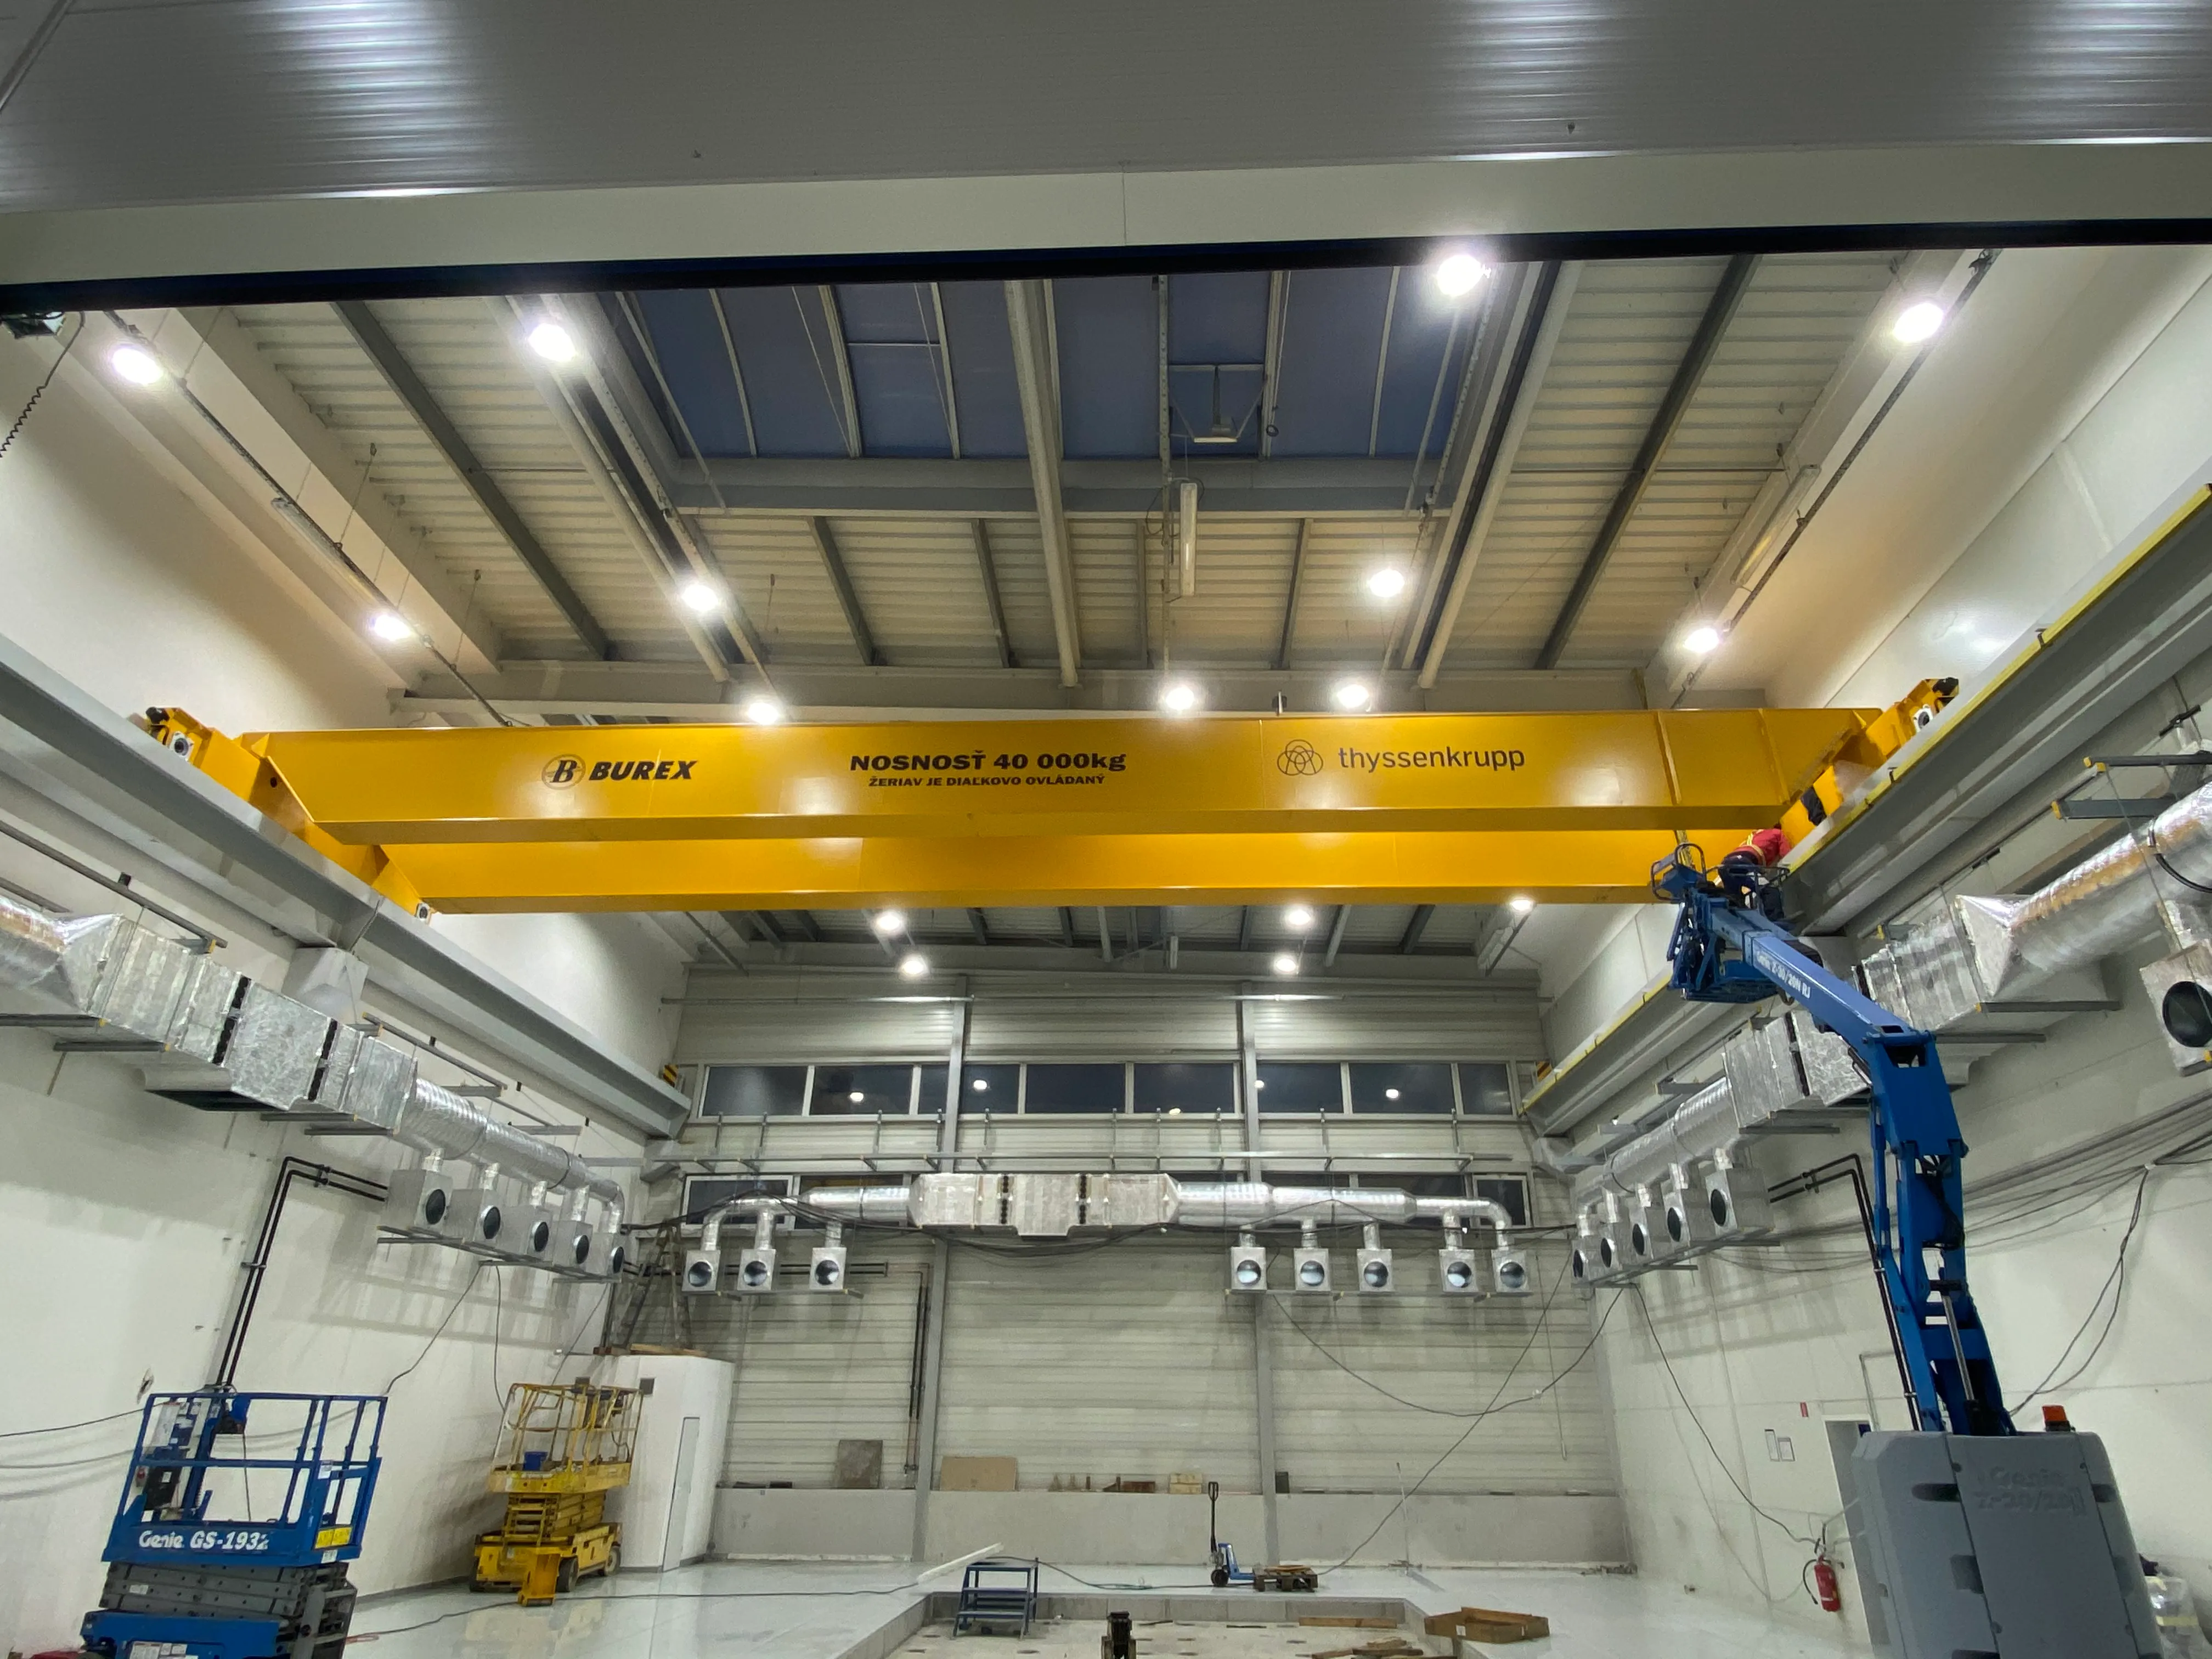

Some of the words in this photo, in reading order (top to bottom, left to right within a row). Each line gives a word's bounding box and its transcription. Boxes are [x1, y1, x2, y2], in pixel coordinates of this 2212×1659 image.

[588, 759, 699, 781] BUREX
[850, 749, 986, 771] NOSNOSŤ
[993, 753, 1029, 769] 40
[1037, 753, 1127, 771] 000kg
[1338, 746, 1525, 773] thyssenkrupp
[868, 776, 923, 787] ŽERIAV
[926, 777, 943, 786] JE
[1025, 773, 1105, 786] OVLÁDANÝ
[138, 1530, 185, 1549] Genie
[190, 1530, 269, 1550] GS-1932
